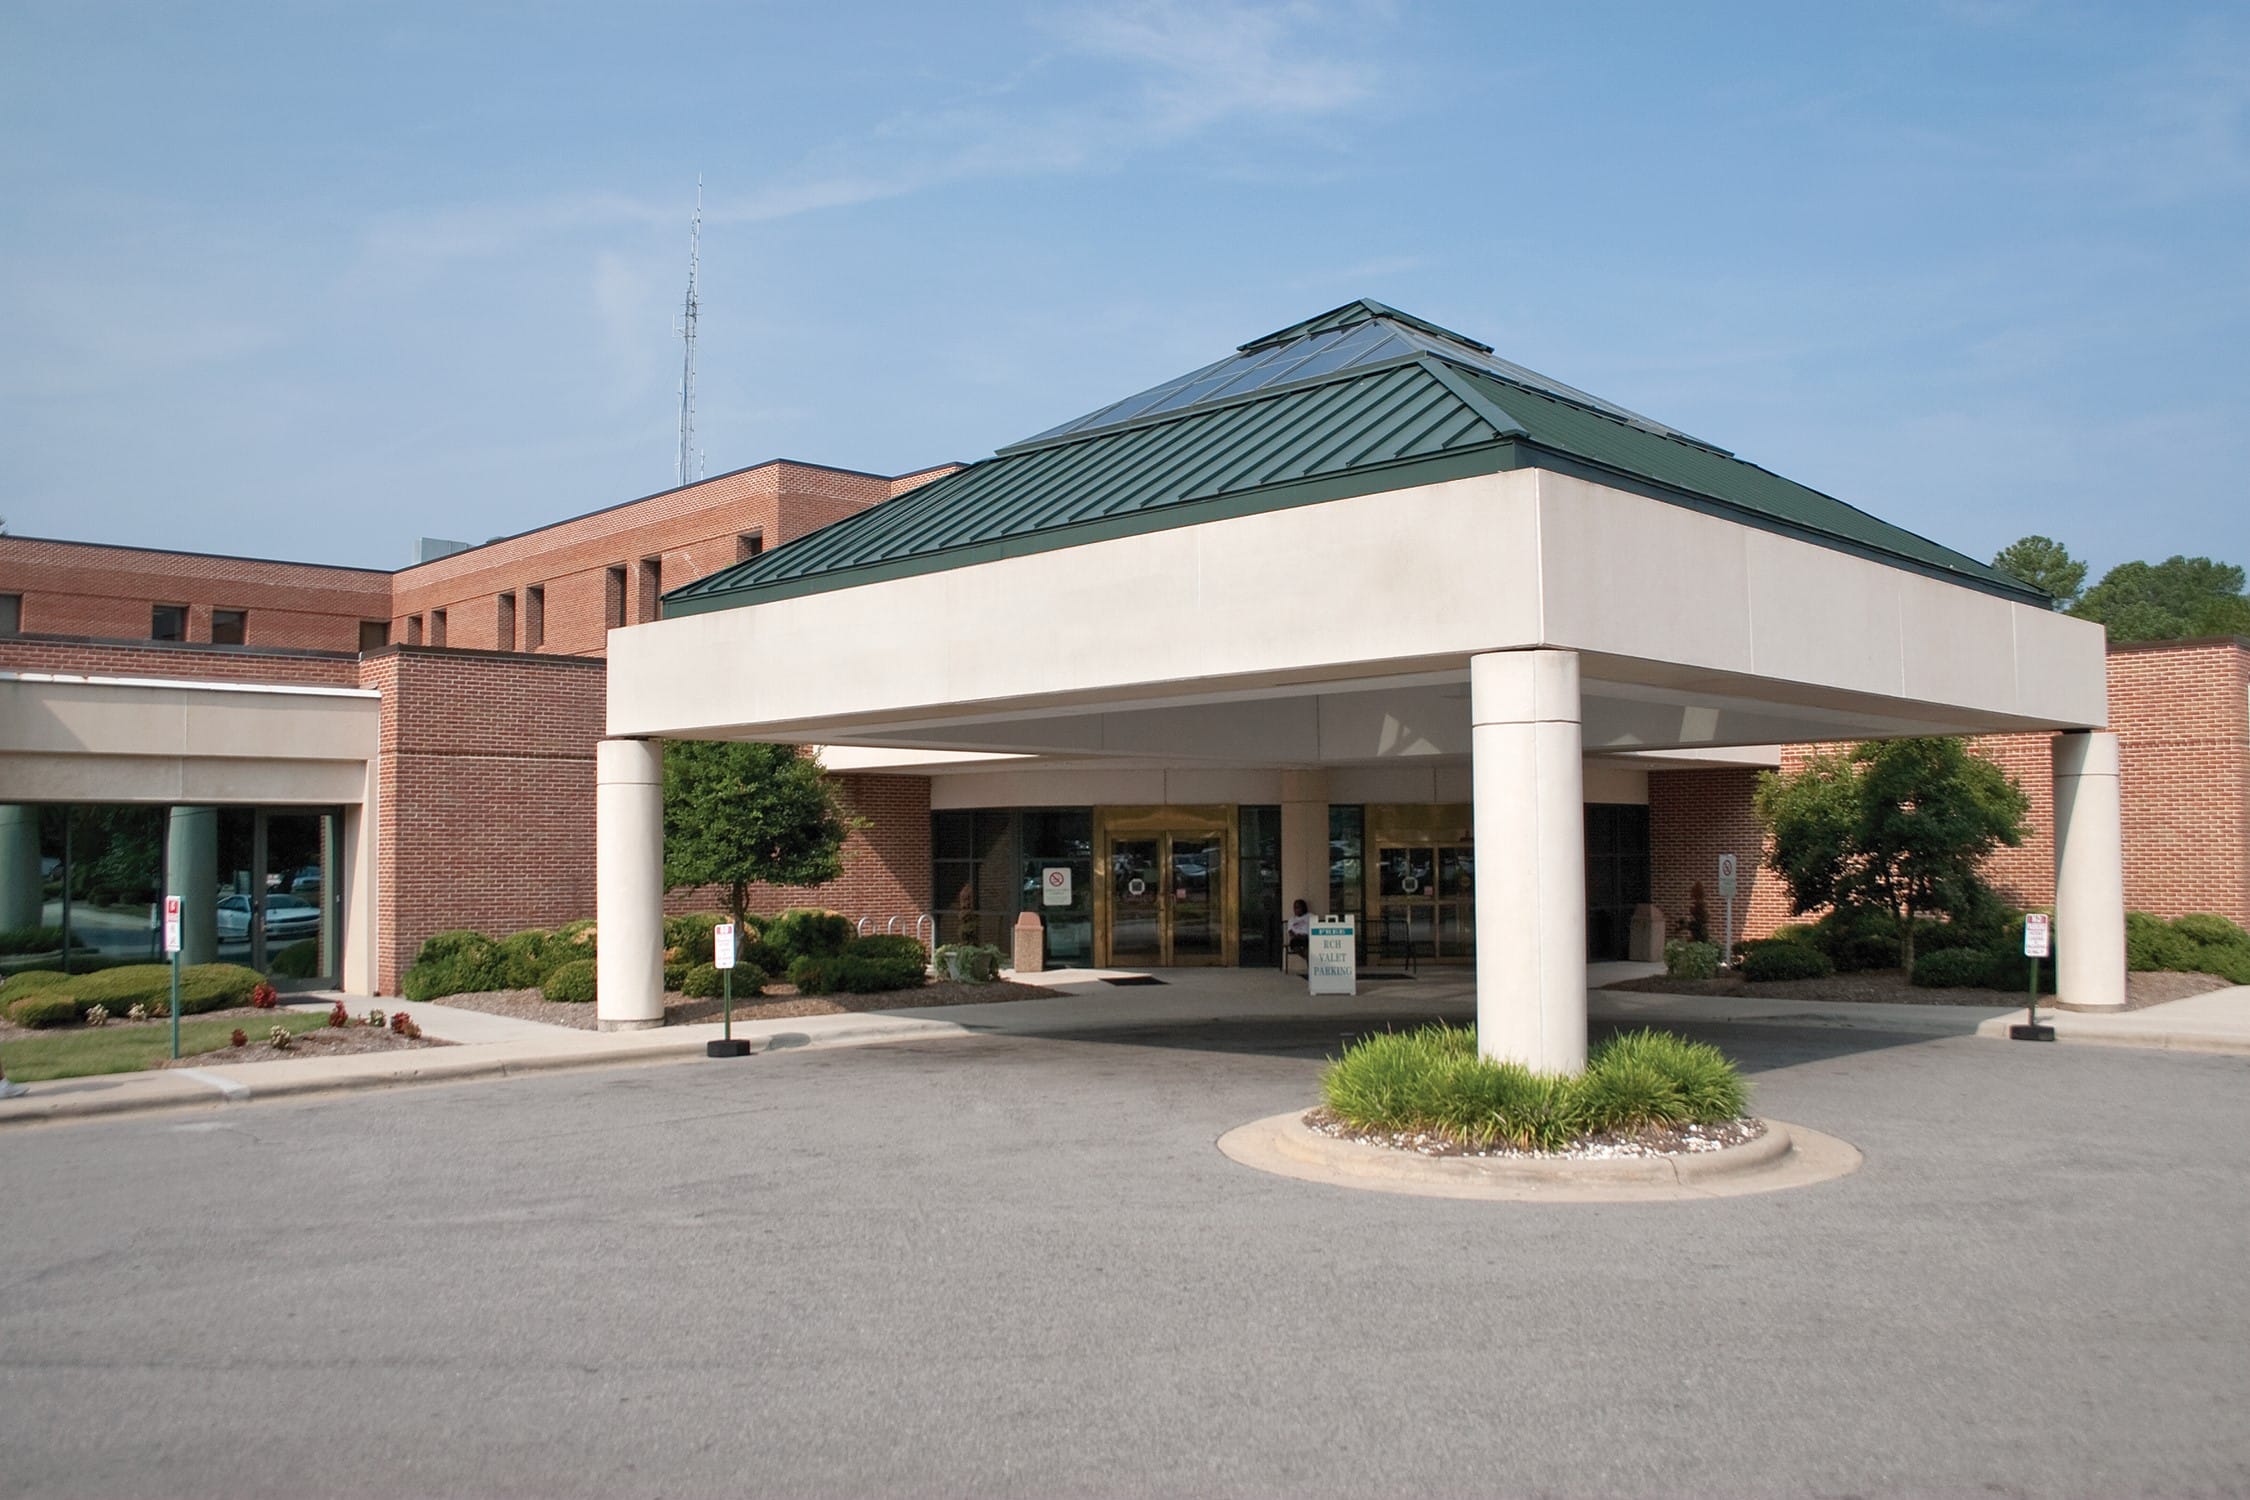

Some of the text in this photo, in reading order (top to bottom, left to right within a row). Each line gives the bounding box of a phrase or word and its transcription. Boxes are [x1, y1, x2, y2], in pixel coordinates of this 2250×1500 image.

[1323, 940, 1342, 949] RCH
[1319, 953, 1347, 962] VALET
[1313, 966, 1352, 976] PARKING
